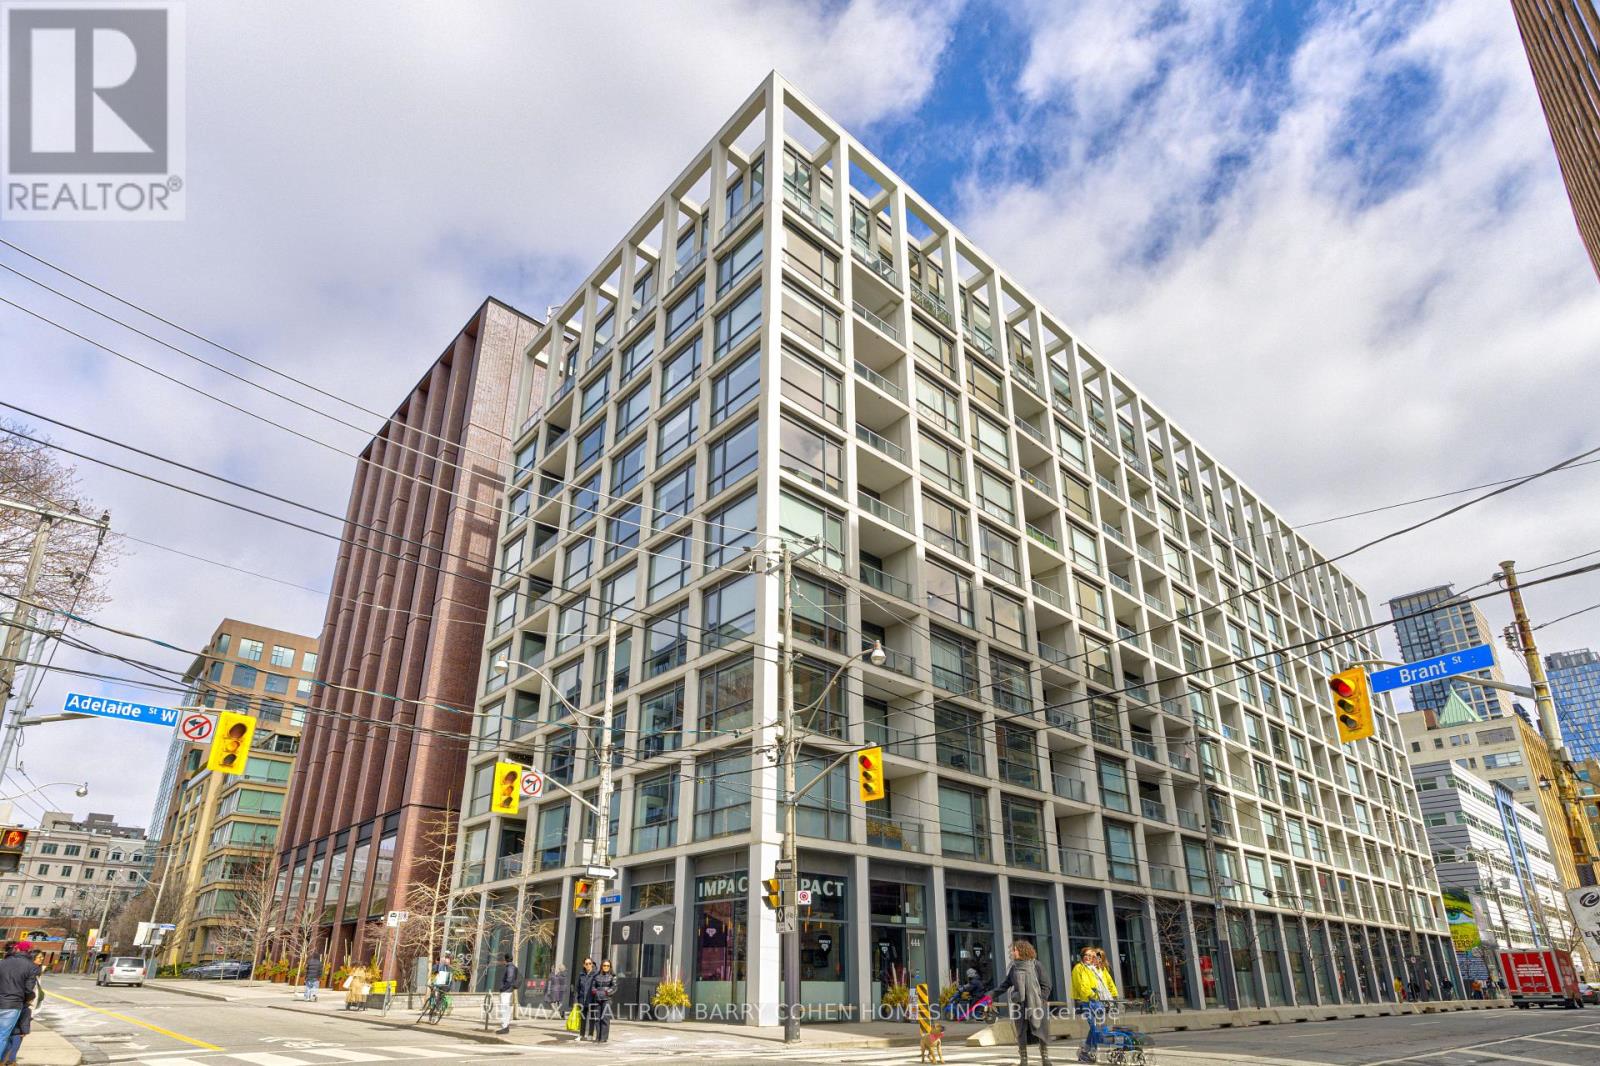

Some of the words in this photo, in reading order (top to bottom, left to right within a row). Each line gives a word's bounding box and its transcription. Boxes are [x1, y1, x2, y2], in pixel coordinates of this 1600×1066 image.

[1399, 660, 1448, 683] Brant
[1451, 655, 1462, 665] St
[67, 695, 142, 718] Adelaide
[148, 706, 158, 715] St
[161, 710, 177, 723] W
[699, 876, 748, 898] IMPAC
[800, 878, 844, 897] PACT
